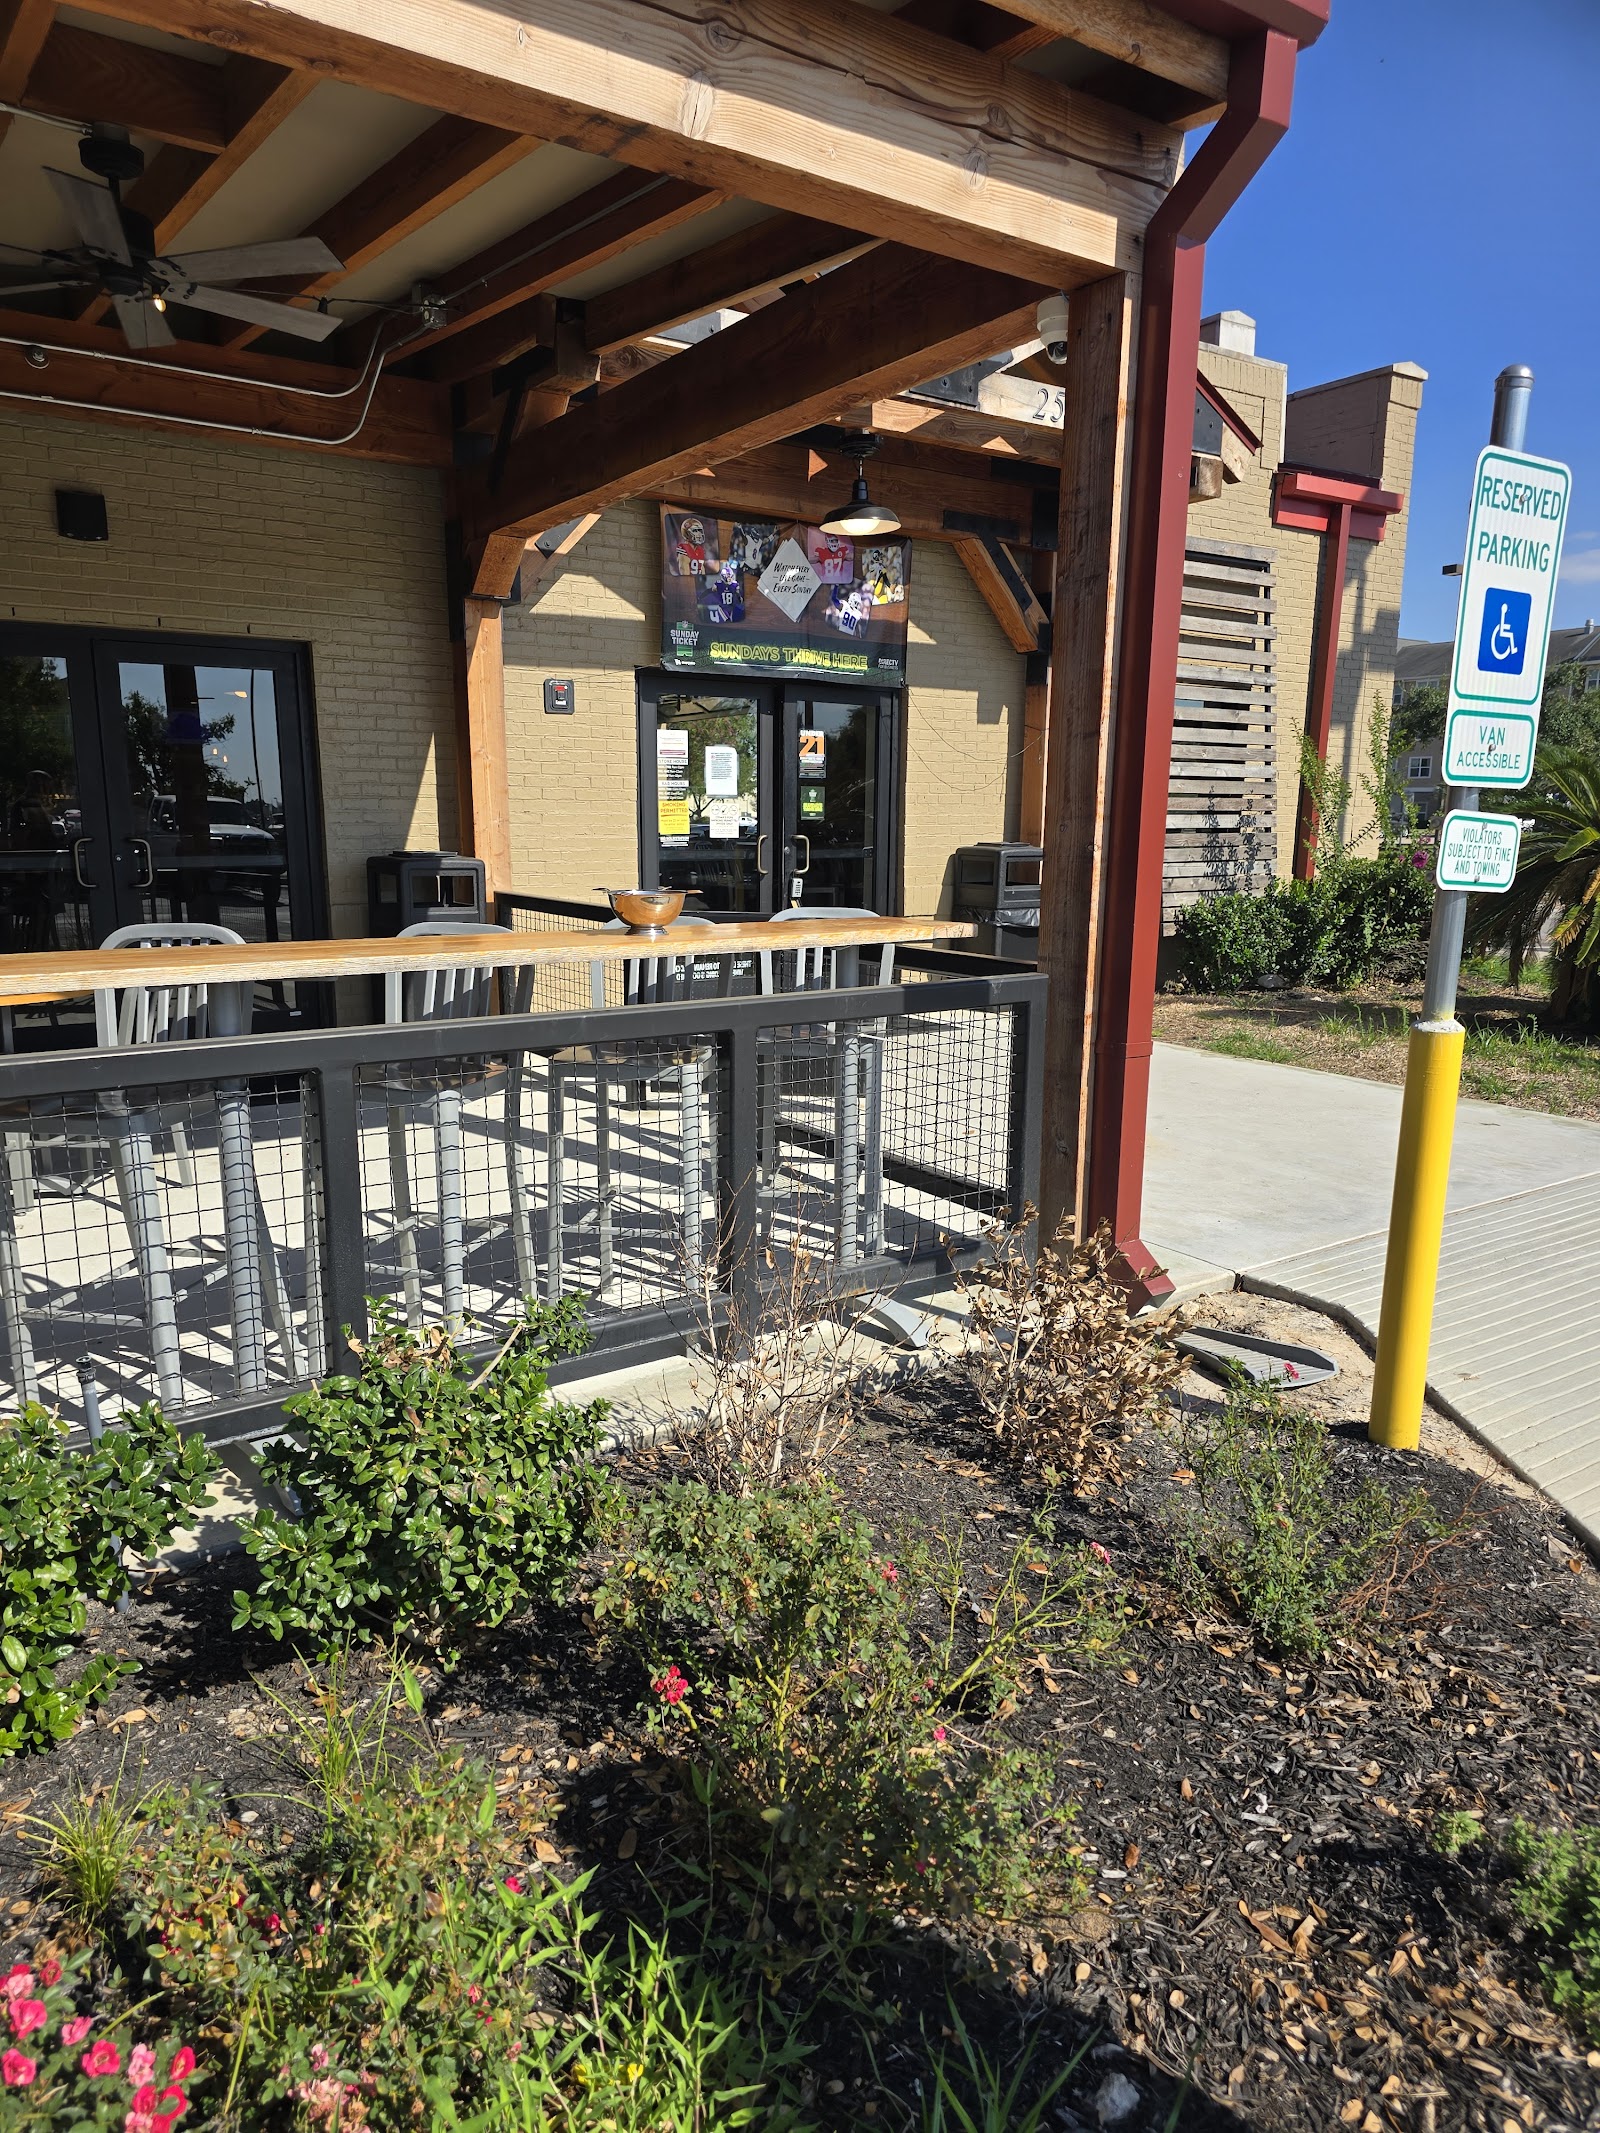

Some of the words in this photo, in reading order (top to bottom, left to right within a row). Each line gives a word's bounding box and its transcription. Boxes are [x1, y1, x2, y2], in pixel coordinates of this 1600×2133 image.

[1480, 475, 1562, 521] RESERVED
[1477, 530, 1550, 573] PARKING
[824, 558, 843, 578] 87
[773, 583, 791, 593] EVERY
[721, 592, 733, 605] 18
[841, 611, 857, 631] 90
[670, 629, 700, 639] SUNDAY
[671, 637, 698, 646] TICKET
[710, 641, 781, 661] SUNDAYS
[782, 647, 831, 668] THRIVE
[831, 653, 868, 671] HERE
[800, 729, 824, 737] UNDER
[1480, 725, 1506, 746] VAN
[799, 736, 824, 757] 21
[1456, 750, 1521, 770] ACCESSIBLE
[1462, 827, 1503, 846] VIOLATORS
[1448, 843, 1482, 860] SUBJECT
[1483, 846, 1493, 860] TO
[1494, 847, 1512, 862] FINE
[1453, 859, 1470, 875] AND
[1472, 861, 1501, 877] TOWING
